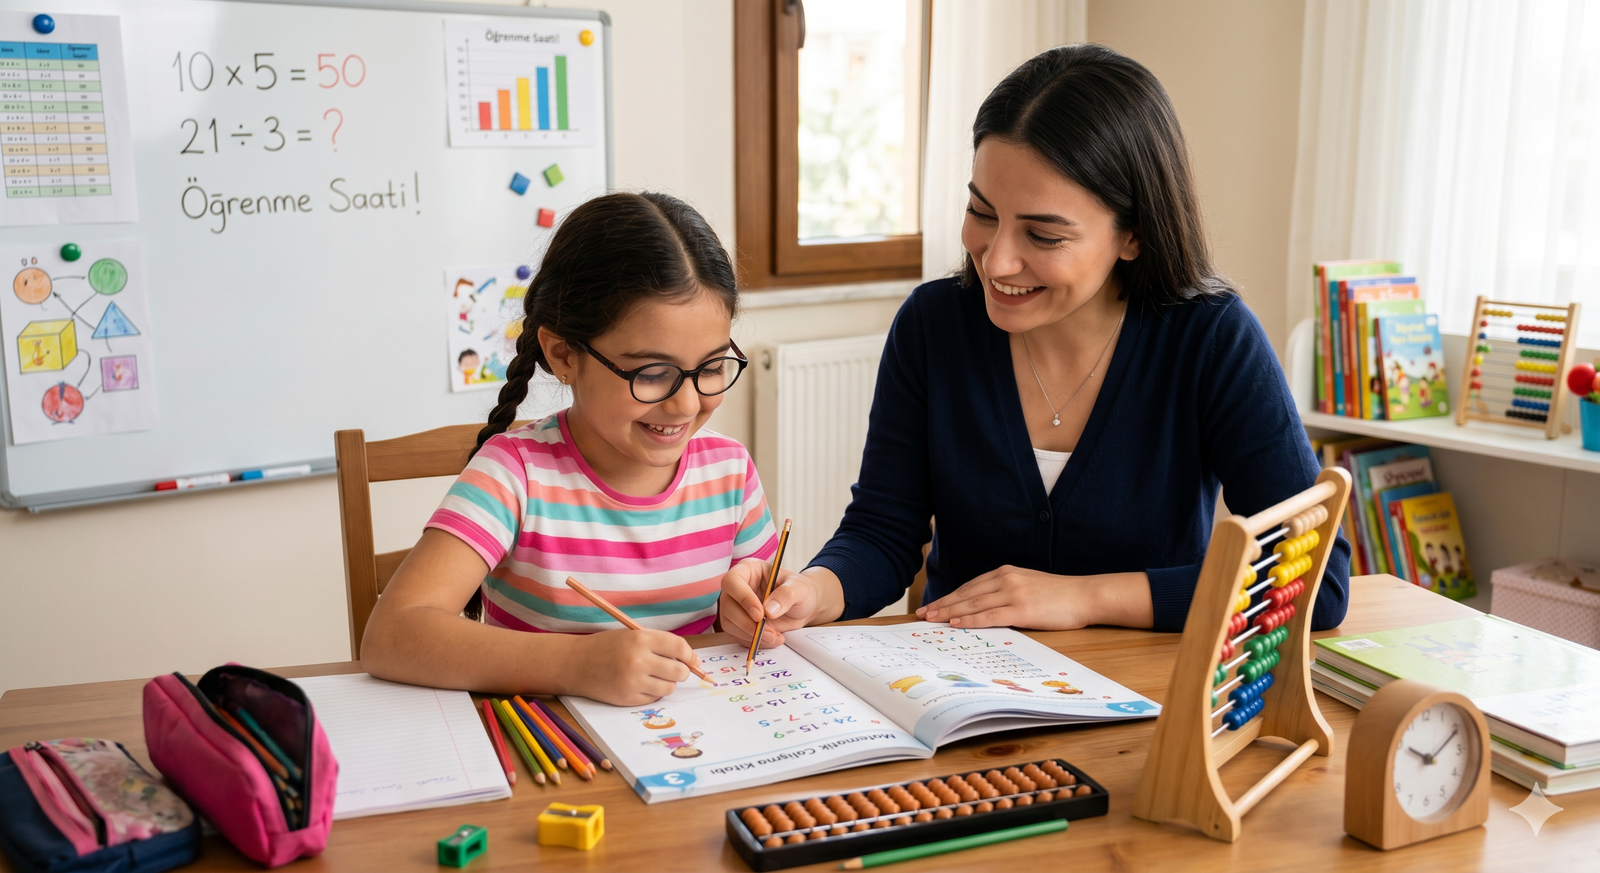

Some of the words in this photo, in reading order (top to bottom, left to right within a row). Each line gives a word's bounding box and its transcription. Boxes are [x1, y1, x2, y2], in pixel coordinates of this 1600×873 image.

[172, 50, 214, 92] 10
[254, 52, 277, 90] 5
[290, 69, 306, 81] =
[317, 53, 366, 89] 50
[180, 117, 219, 154] 21
[231, 124, 253, 146] ÷
[263, 116, 286, 152] 3
[297, 129, 312, 141] =
[323, 107, 344, 153] ?
[181, 177, 313, 234] Öğrenme
[732, 678, 750, 686] 15
[800, 691, 821, 700] 12
[819, 706, 840, 714] 12
[1422, 709, 1431, 722] 12
[788, 714, 800, 722] 7
[833, 715, 856, 724] 24
[799, 722, 820, 733] 15
[773, 731, 785, 739] 9
[818, 733, 896, 750] Matematik
[1456, 744, 1462, 756] 3
[1451, 767, 1458, 777] 4
[663, 772, 685, 785] 3
[1439, 785, 1445, 797] 5
[1407, 794, 1413, 806] 7
[1423, 795, 1429, 807] 6
